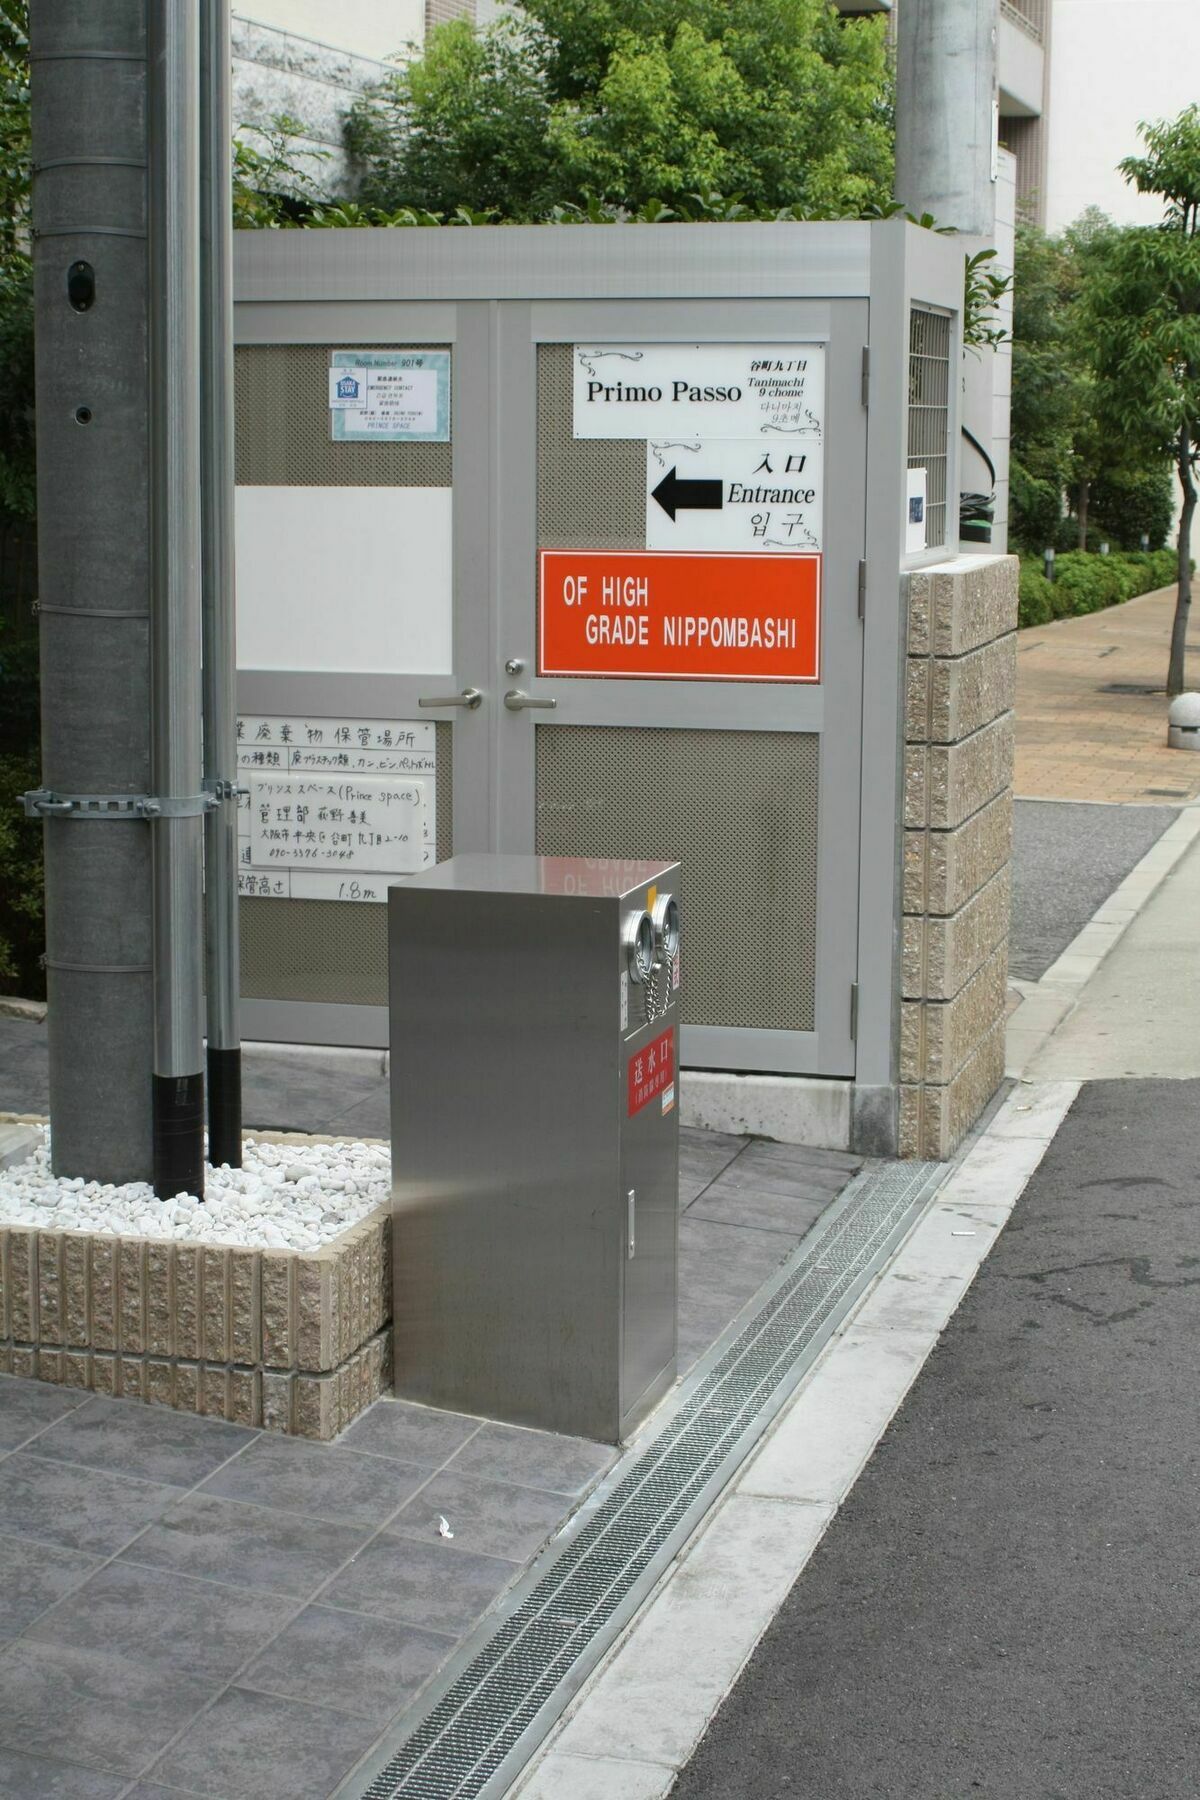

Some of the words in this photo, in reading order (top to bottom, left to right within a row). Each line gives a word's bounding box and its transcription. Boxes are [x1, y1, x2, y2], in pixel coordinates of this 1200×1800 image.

[751, 360, 807, 371] 谷町九丁目
[587, 382, 662, 402] Primo
[672, 382, 742, 402] Passo
[748, 377, 804, 387] Tanimachi
[759, 388, 766, 397] 9
[769, 388, 803, 397] chome
[752, 453, 806, 474] 入口
[727, 483, 815, 504] Entrance
[563, 575, 588, 605] OF
[602, 576, 648, 607] HIGH
[585, 614, 649, 645] GRADE
[663, 616, 797, 648] NIPPOMBASHI
[237, 751, 281, 767] の種類
[259, 803, 309, 824] 管理部
[635, 1039, 668, 1086] 送水口
